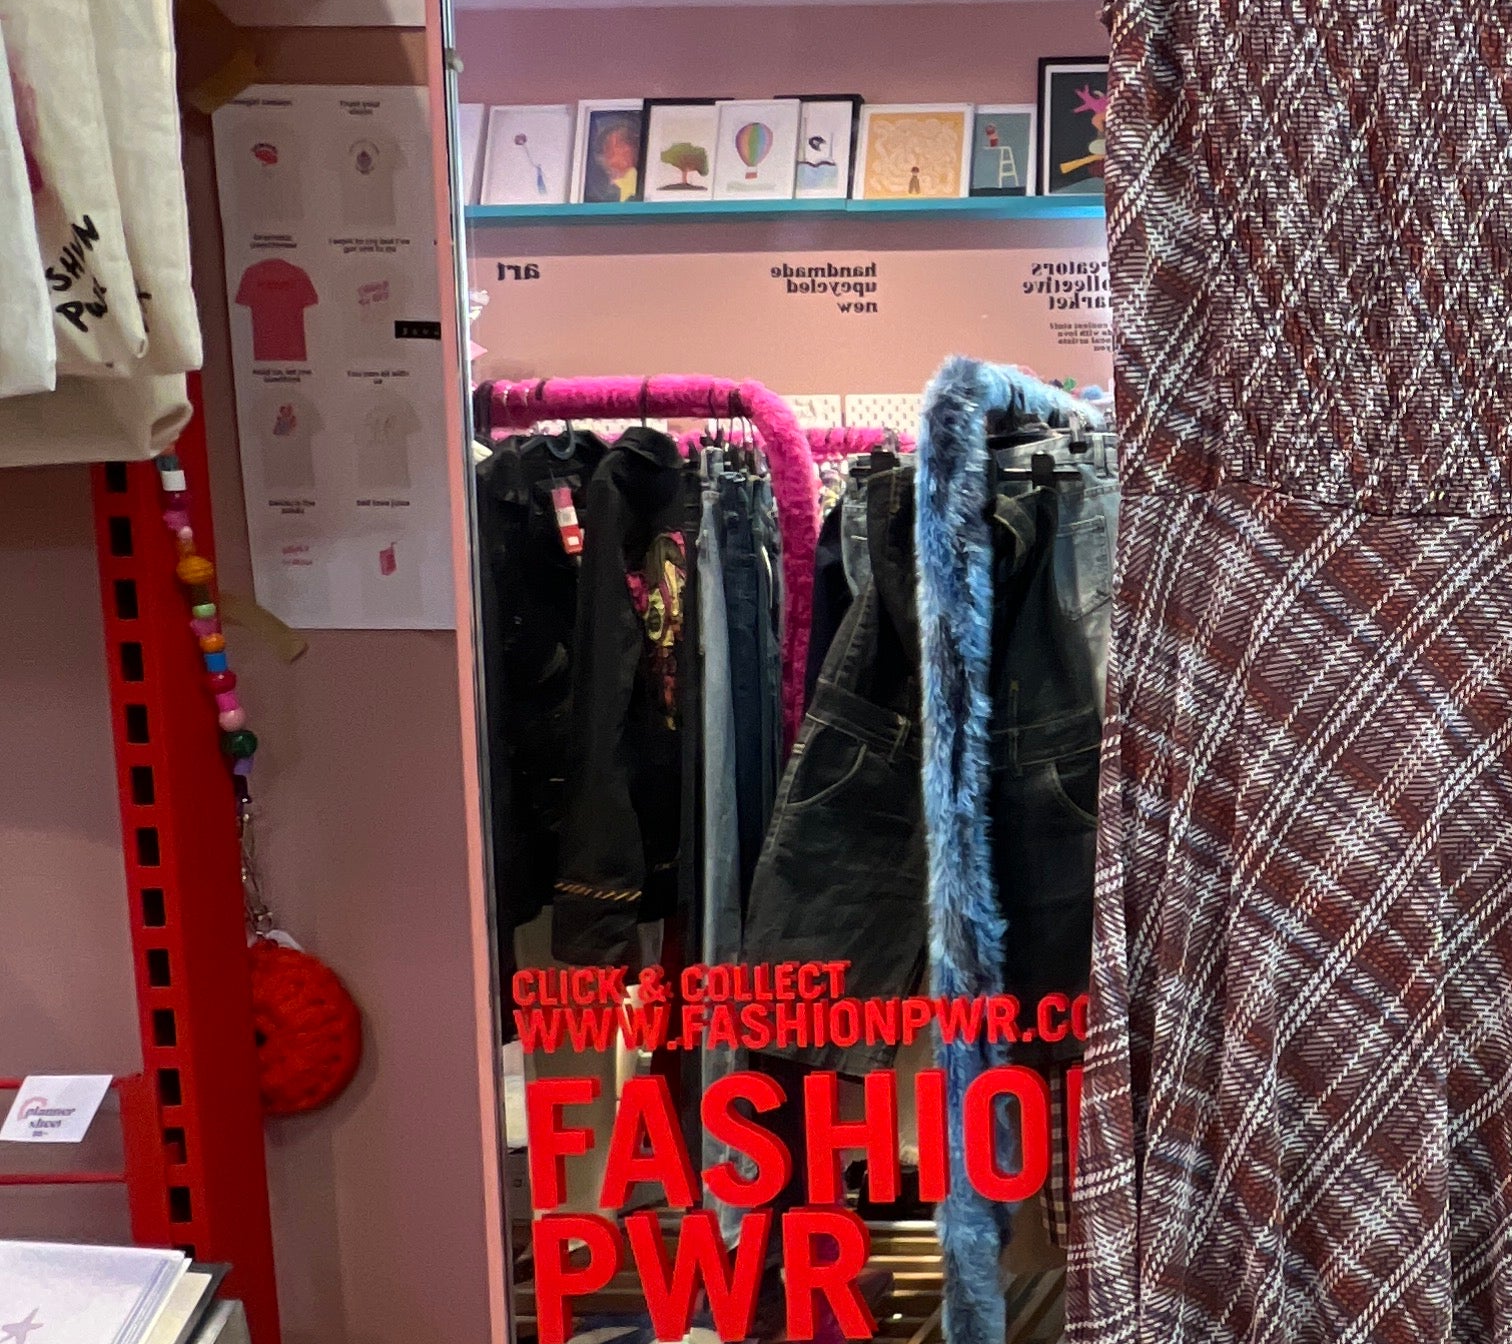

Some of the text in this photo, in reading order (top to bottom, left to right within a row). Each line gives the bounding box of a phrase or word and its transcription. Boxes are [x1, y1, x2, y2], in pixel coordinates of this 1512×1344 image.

[513, 959, 851, 1006] CLICK & COLLECT
[526, 1065, 1084, 1210] FASHIO
